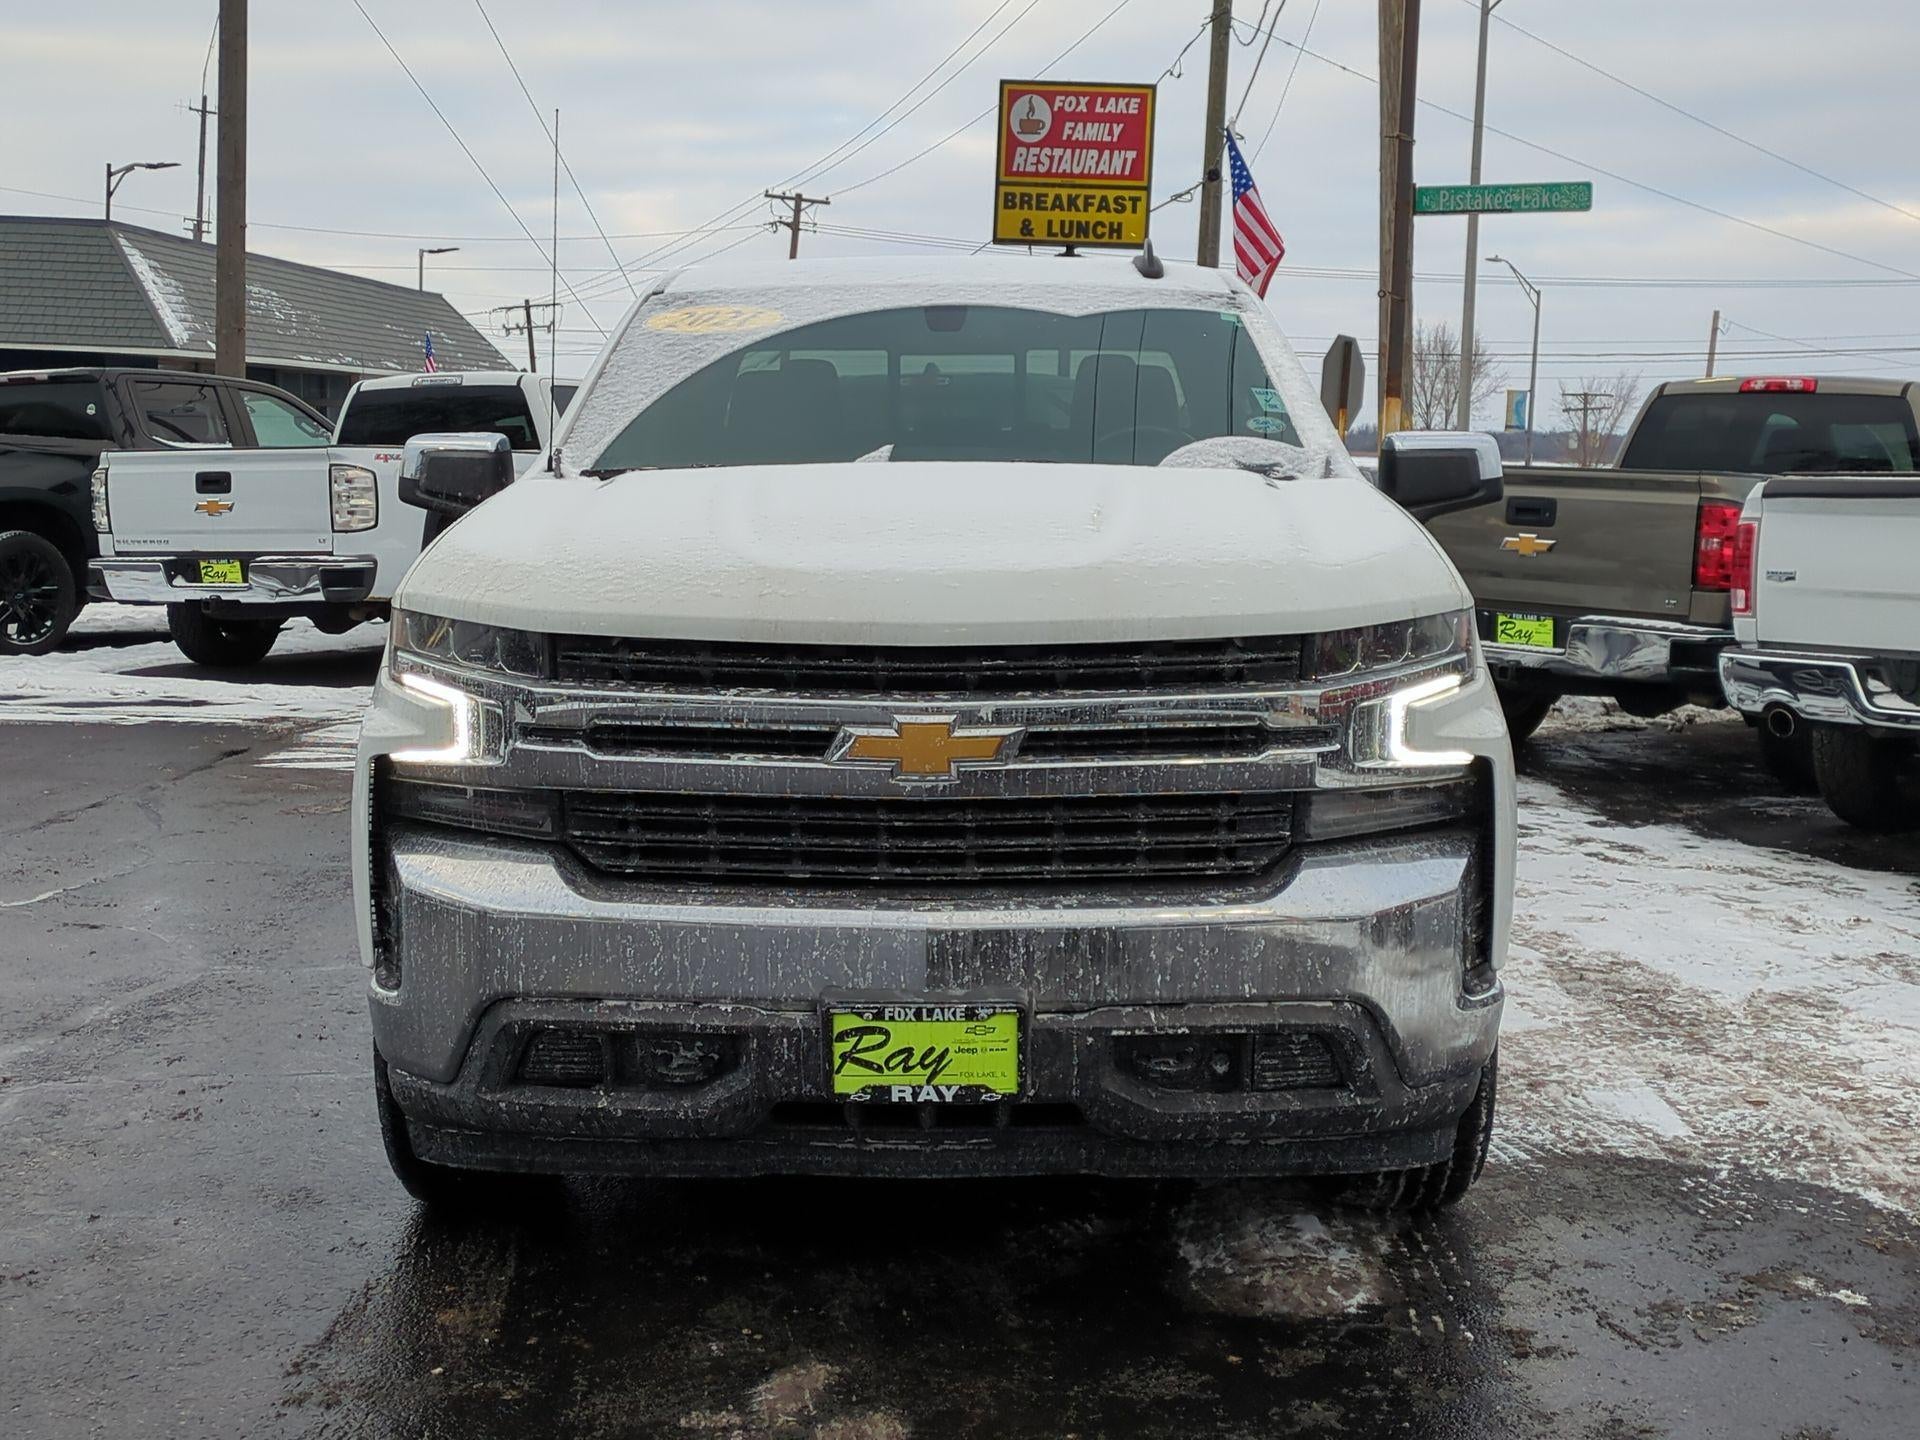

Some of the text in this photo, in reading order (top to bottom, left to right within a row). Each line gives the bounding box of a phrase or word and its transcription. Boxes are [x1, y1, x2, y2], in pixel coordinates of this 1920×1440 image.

[1053, 95, 1141, 114] FOX LAKE
[1062, 121, 1125, 143] FAMILY
[1012, 147, 1137, 176] RESTAURANT
[1003, 191, 1142, 214] BREAKFAST
[1521, 189, 1561, 208] Lake
[1019, 218, 1123, 240] & LUNCH
[202, 565, 227, 583] Ray
[1499, 621, 1534, 644] Ray
[884, 1008, 916, 1021] FOX
[922, 1008, 966, 1021] LAKE
[834, 1025, 953, 1084] Ray
[954, 1046, 978, 1055] Jeep
[891, 1085, 961, 1102] RAY
